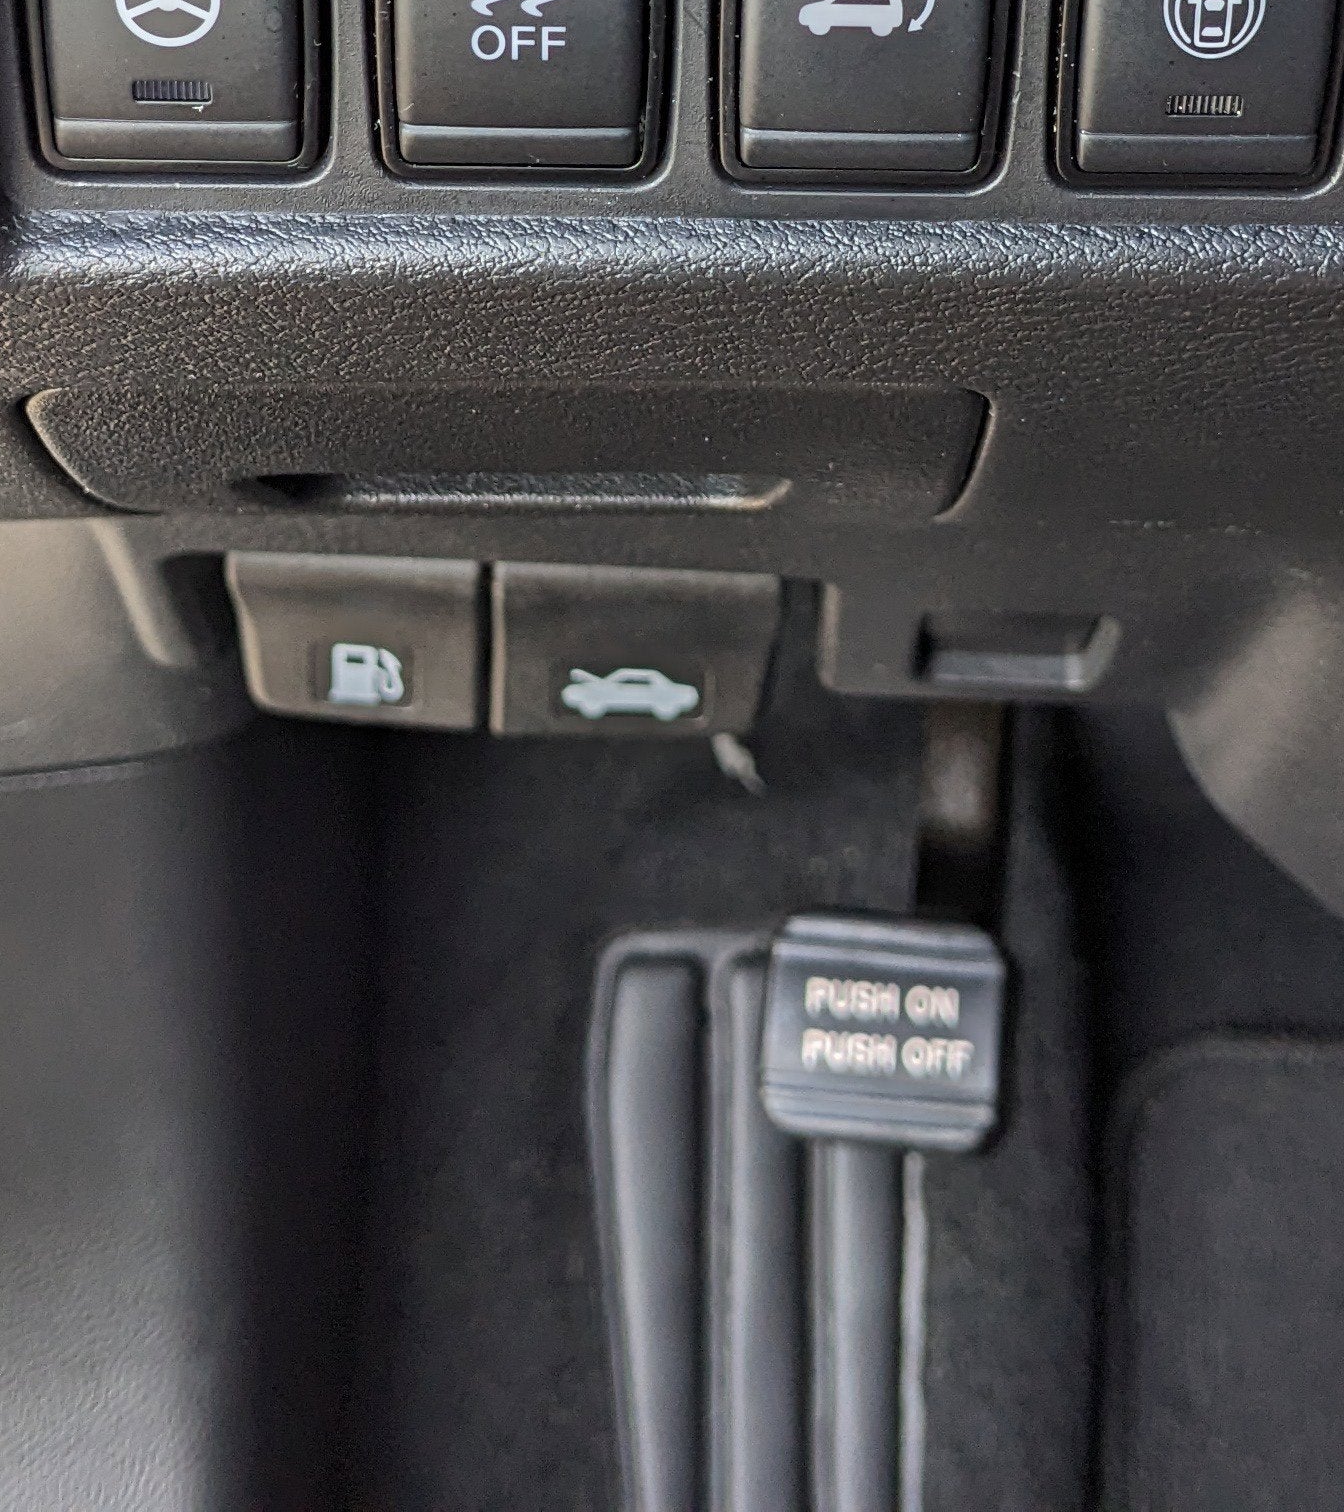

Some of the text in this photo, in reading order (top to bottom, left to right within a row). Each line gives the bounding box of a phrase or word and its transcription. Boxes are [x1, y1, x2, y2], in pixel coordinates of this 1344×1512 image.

[471, 24, 567, 61] OFF
[804, 975, 960, 1029] PUSH ON
[801, 1027, 975, 1081] PUSH OFF
